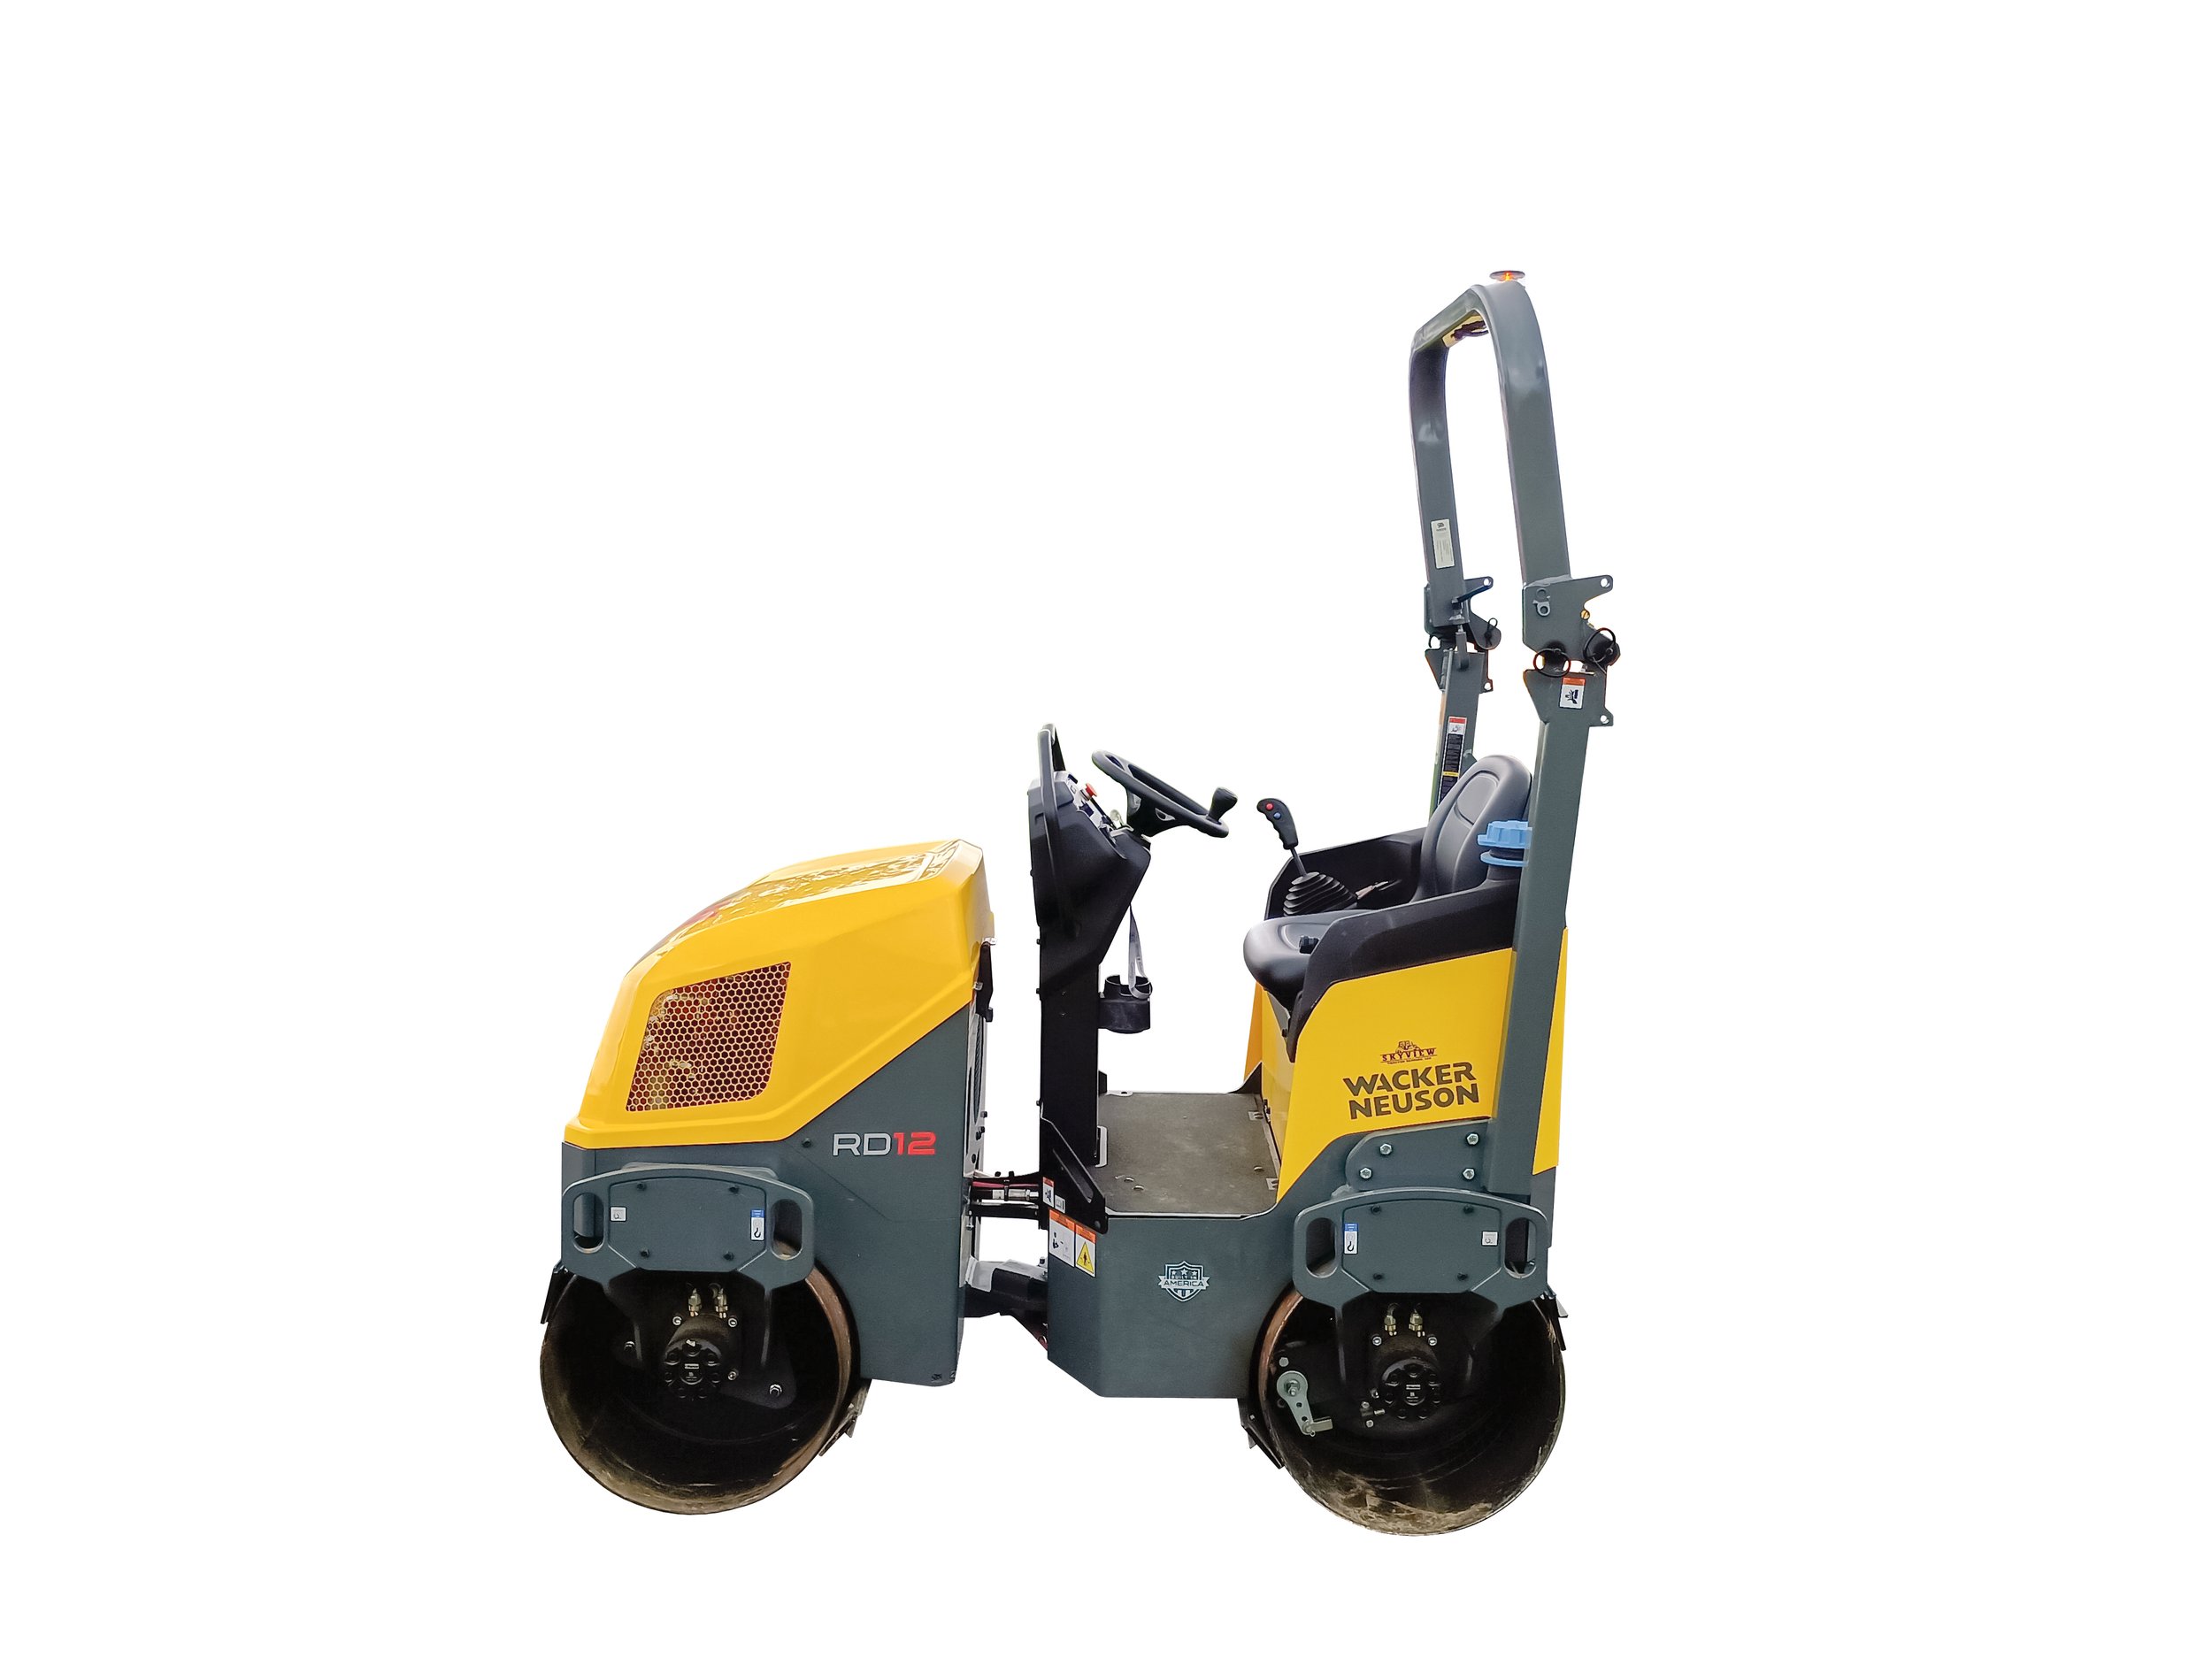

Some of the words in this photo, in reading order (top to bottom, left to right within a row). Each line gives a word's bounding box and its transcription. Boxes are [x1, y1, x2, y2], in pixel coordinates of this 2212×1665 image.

[1382, 1048, 1435, 1062] SKYVIEW
[1342, 1062, 1477, 1097] WACKER
[1348, 1083, 1479, 1120] NEUSON
[833, 1132, 936, 1156] RD12
